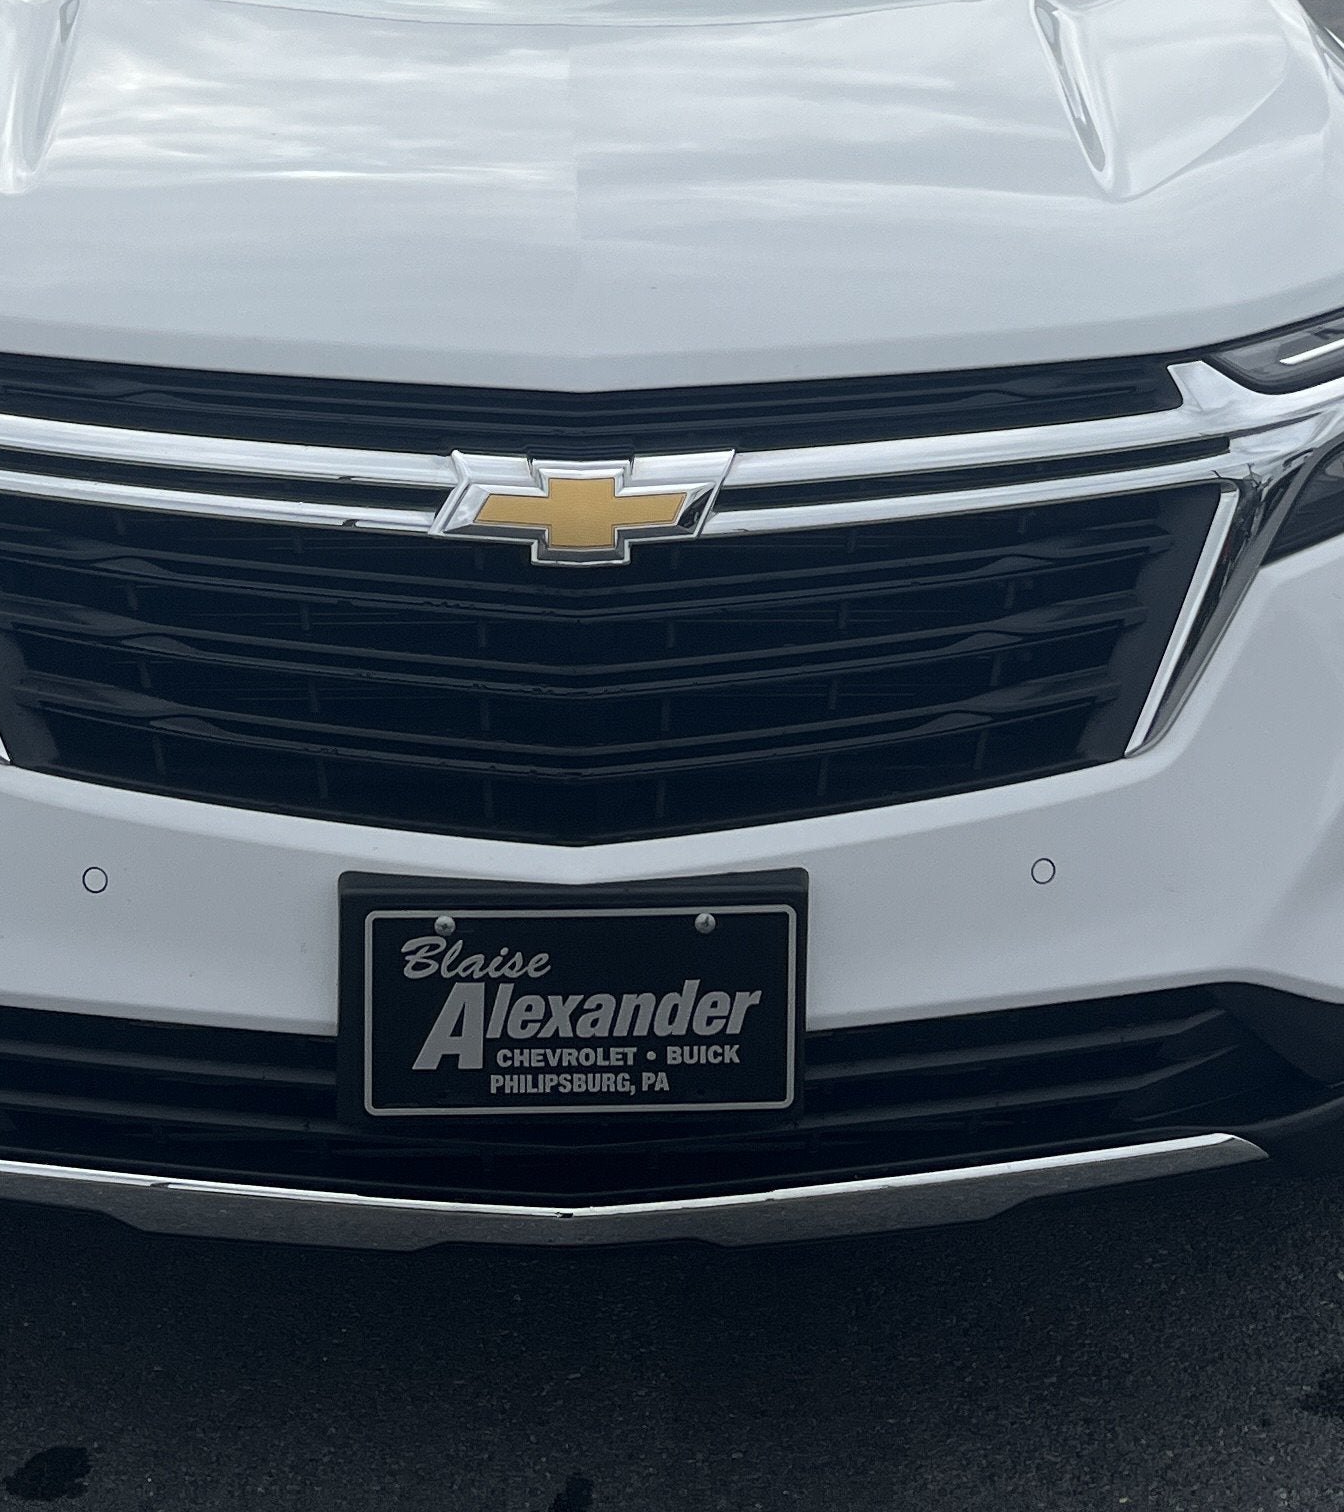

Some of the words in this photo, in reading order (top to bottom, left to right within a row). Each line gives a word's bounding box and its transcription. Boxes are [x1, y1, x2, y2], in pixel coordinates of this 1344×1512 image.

[400, 935, 552, 980] Blaise
[412, 978, 763, 1070] Alexander
[496, 1046, 637, 1068] CHEVROLET
[666, 1044, 741, 1065] BUICK
[490, 1071, 636, 1096] PHILIPSBURG,
[641, 1070, 670, 1092] PA
